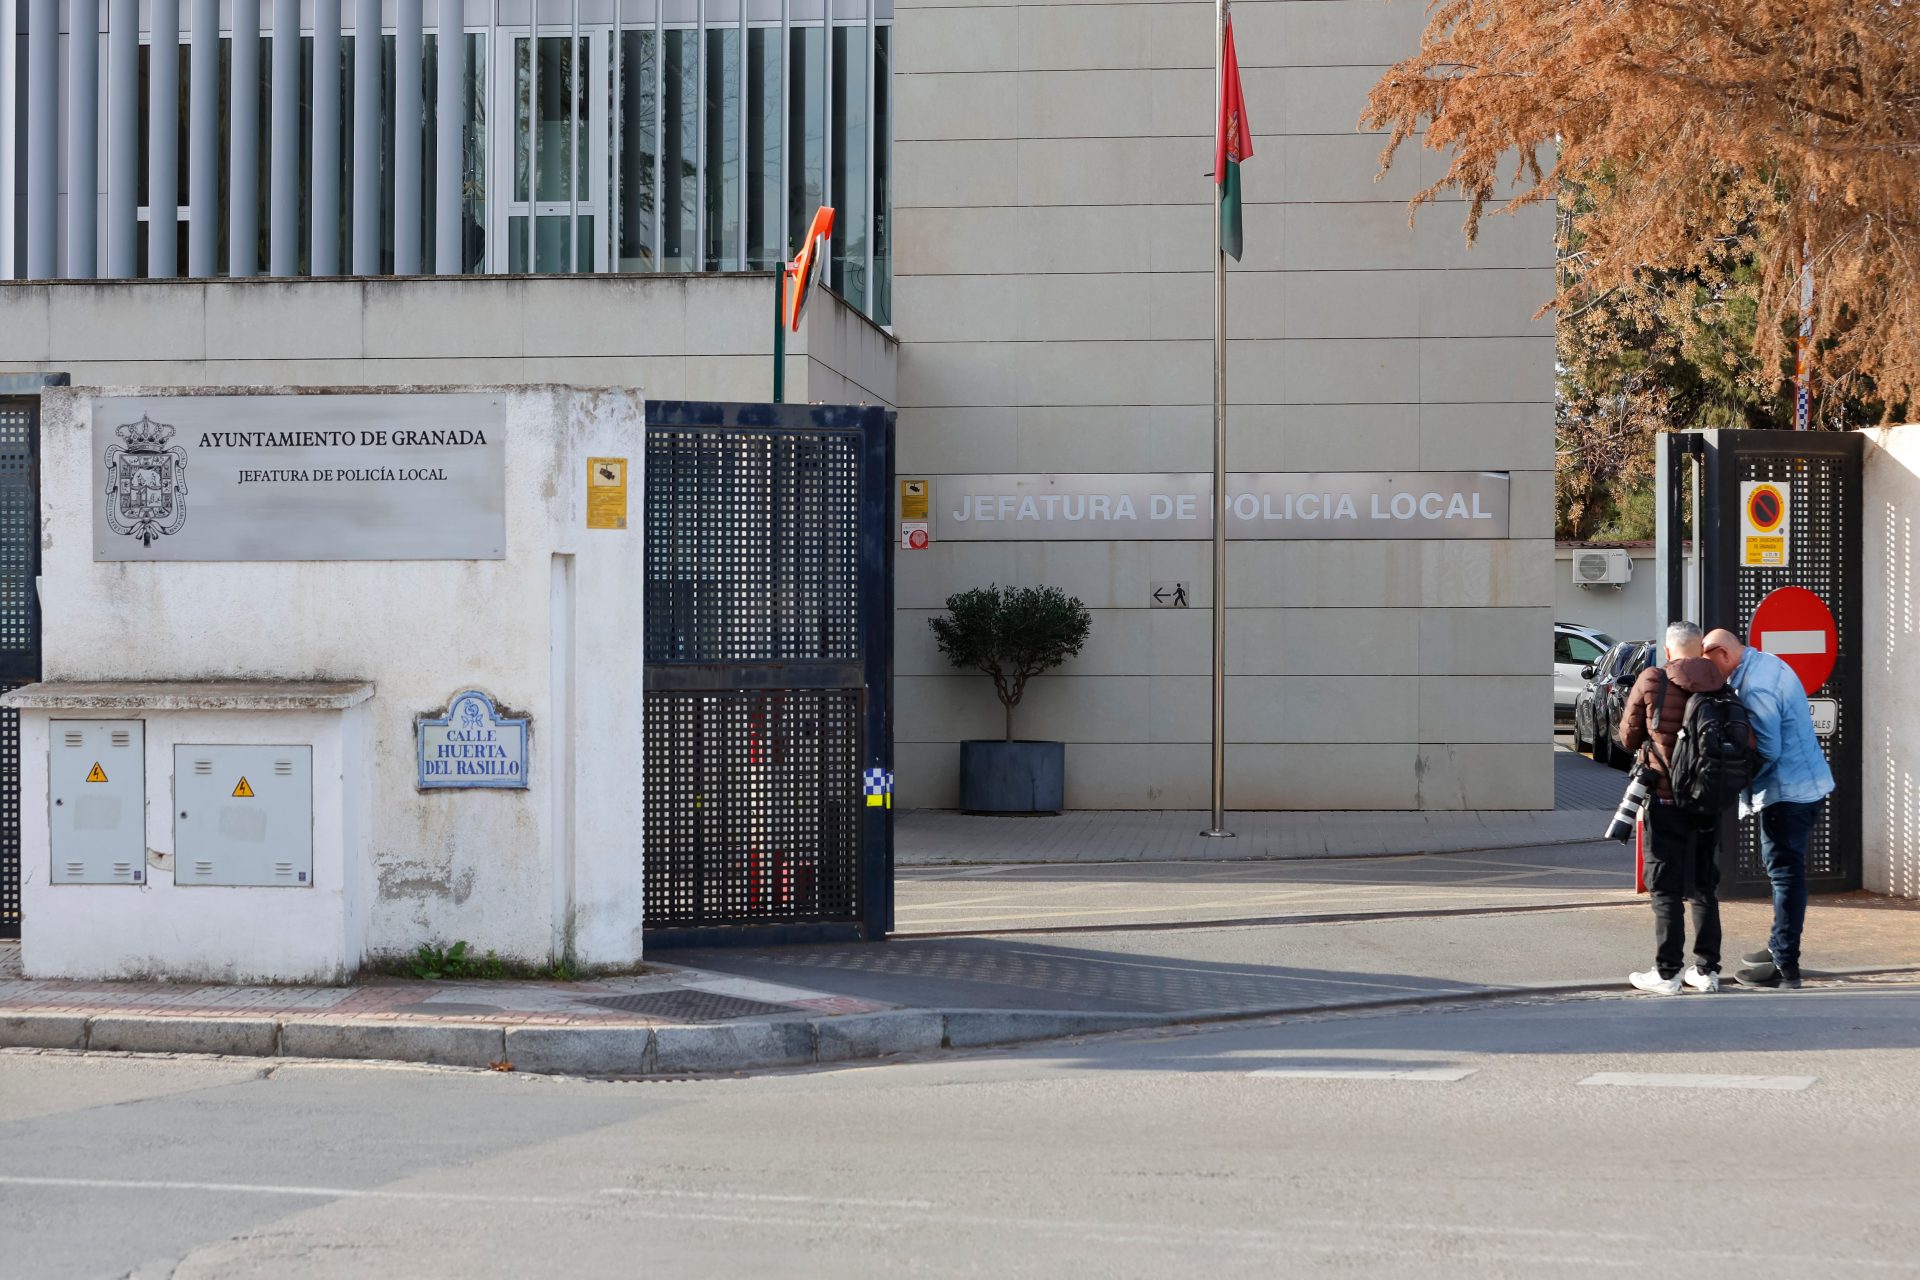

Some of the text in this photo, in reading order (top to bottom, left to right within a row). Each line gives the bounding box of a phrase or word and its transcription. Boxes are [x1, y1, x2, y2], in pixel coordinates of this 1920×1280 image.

[198, 429, 488, 447] AYUNTAMIENTO DE GRANADA
[238, 465, 448, 485] JEFATURA DE POLICÍA LOCAL
[952, 494, 1138, 522] JEFATURA
[1150, 494, 1197, 520] DE
[1371, 492, 1493, 519] LOCAL
[446, 730, 497, 742] CALLE
[437, 744, 507, 758] HUERTA
[425, 760, 520, 776] DEL RASILLO
